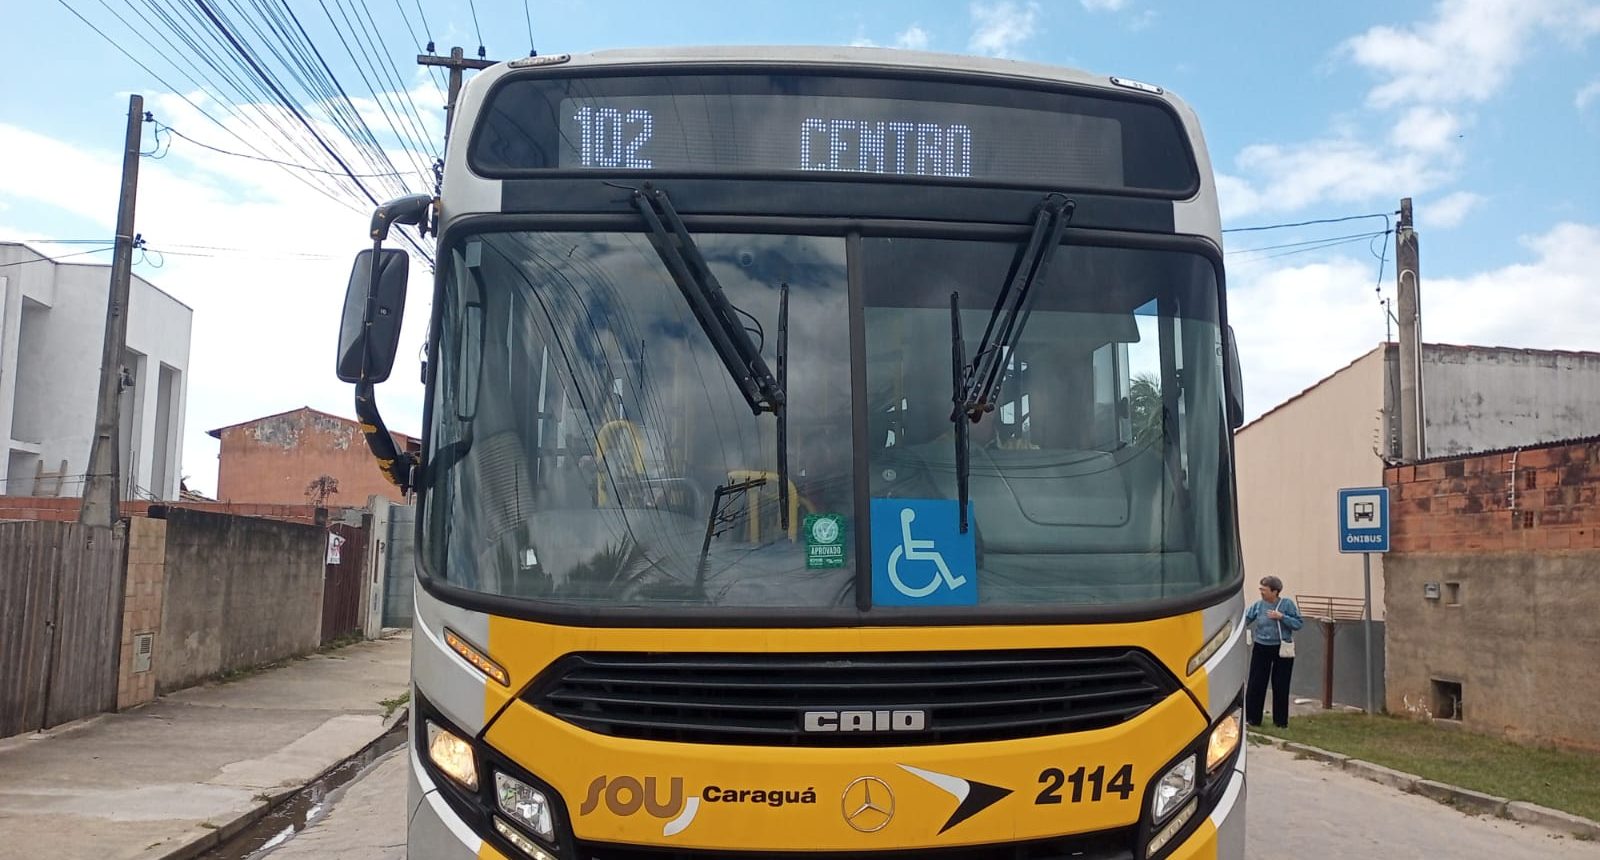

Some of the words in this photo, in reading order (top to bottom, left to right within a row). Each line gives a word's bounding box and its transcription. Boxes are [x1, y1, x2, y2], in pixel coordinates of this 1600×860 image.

[573, 106, 652, 168] 102
[801, 118, 971, 177] CENTRO
[1346, 533, 1382, 543] ÔNIBUS
[811, 546, 841, 555] APROVADO
[804, 710, 925, 732] CAIO
[1034, 764, 1135, 805] 2114
[702, 785, 817, 807] Caraguá
